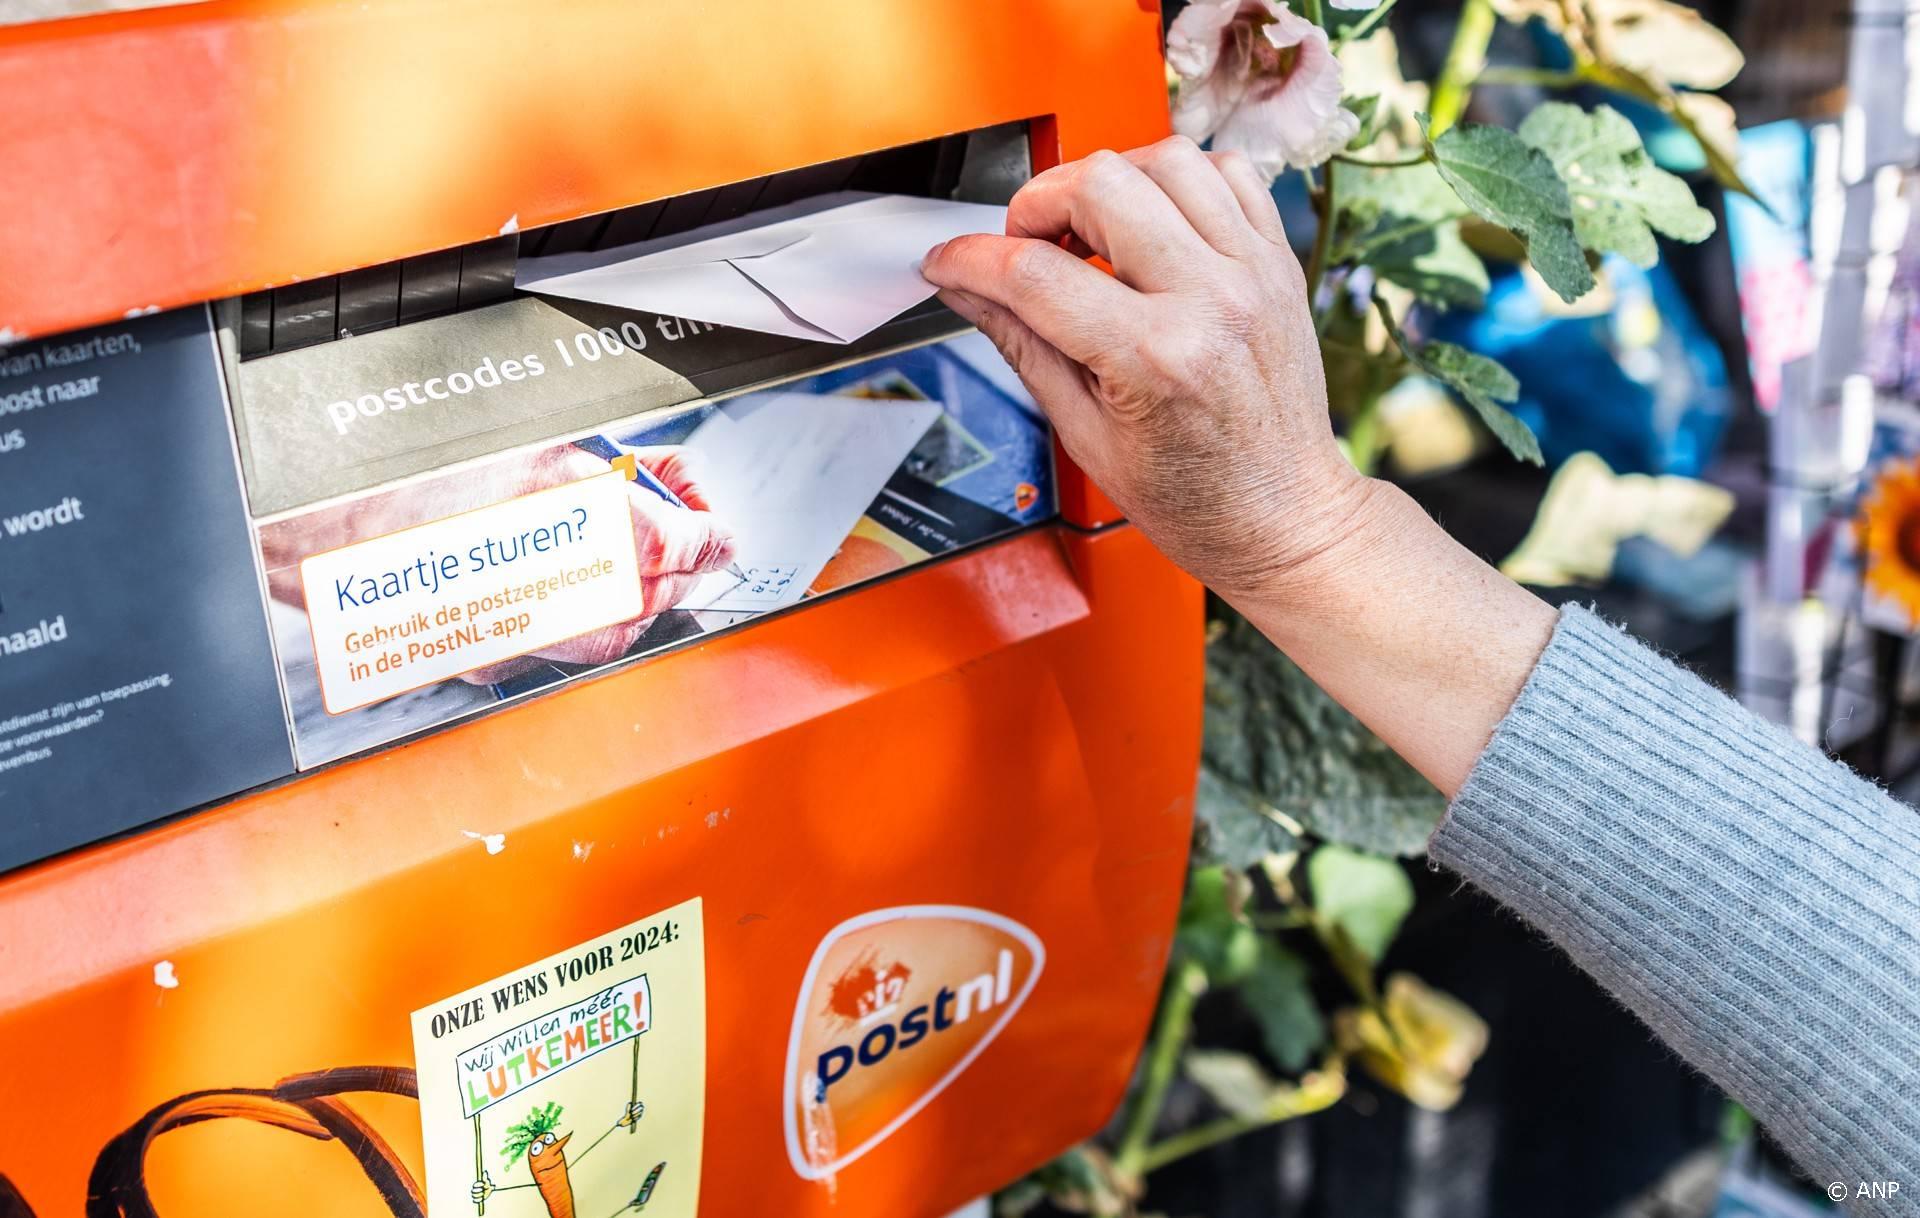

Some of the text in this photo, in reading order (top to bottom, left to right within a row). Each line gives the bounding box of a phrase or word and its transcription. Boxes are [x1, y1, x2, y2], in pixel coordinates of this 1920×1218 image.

[42, 333, 142, 368] kaarten,
[46, 375, 101, 403] naar
[326, 350, 545, 435] postcodes
[554, 321, 647, 368] 1000
[3, 497, 85, 537] wordt
[335, 508, 588, 611] Kaartje sturen?
[345, 558, 614, 653] Gebruik de postzegelcode
[349, 611, 532, 682] in de PostNL-app
[431, 920, 679, 1039] ONZE WENS VOOR 2024:
[467, 991, 646, 1111] LUTKEMEER!
